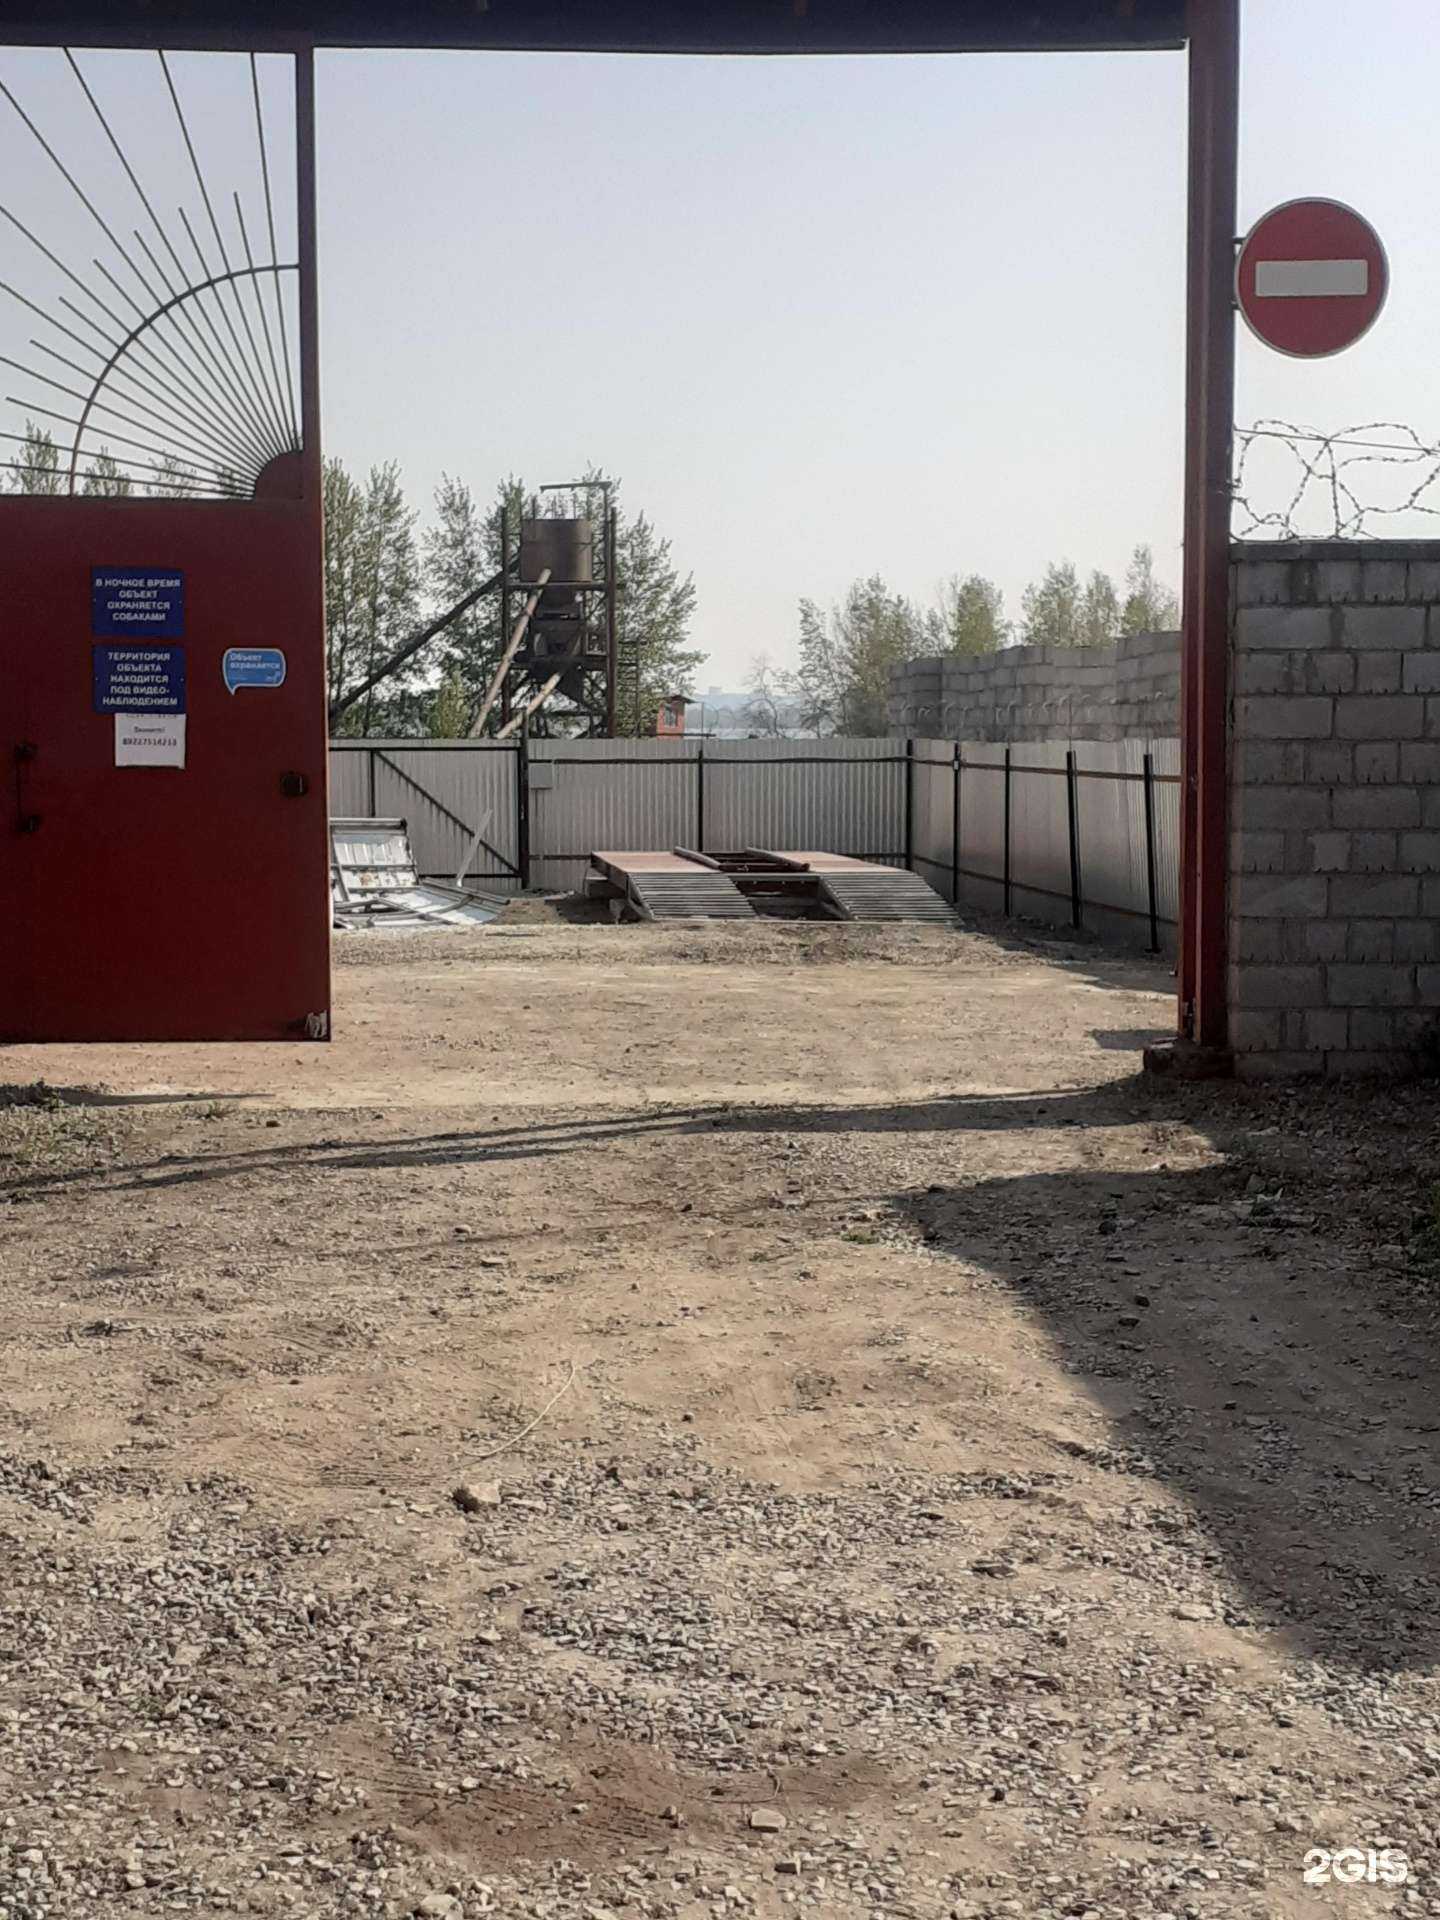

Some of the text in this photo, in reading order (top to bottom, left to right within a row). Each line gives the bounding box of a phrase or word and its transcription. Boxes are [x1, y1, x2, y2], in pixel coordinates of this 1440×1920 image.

[96, 579, 181, 588] В НОЧНОЕ ВРЕМЯ
[119, 590, 158, 599] ОБЪЕКТ
[107, 601, 170, 610] ОХРАНЯЕТСЯ
[112, 612, 166, 621] СОБАКАМИ
[108, 652, 171, 661] ТЕРРИТОРИЯ
[116, 663, 162, 672] ОБЪЕКТА
[110, 674, 169, 684] НАХОДИТСЯ
[110, 685, 170, 695] ПОД ВИДЕО-
[102, 696, 178, 706] НАБЛЮДЕНИЕМ
